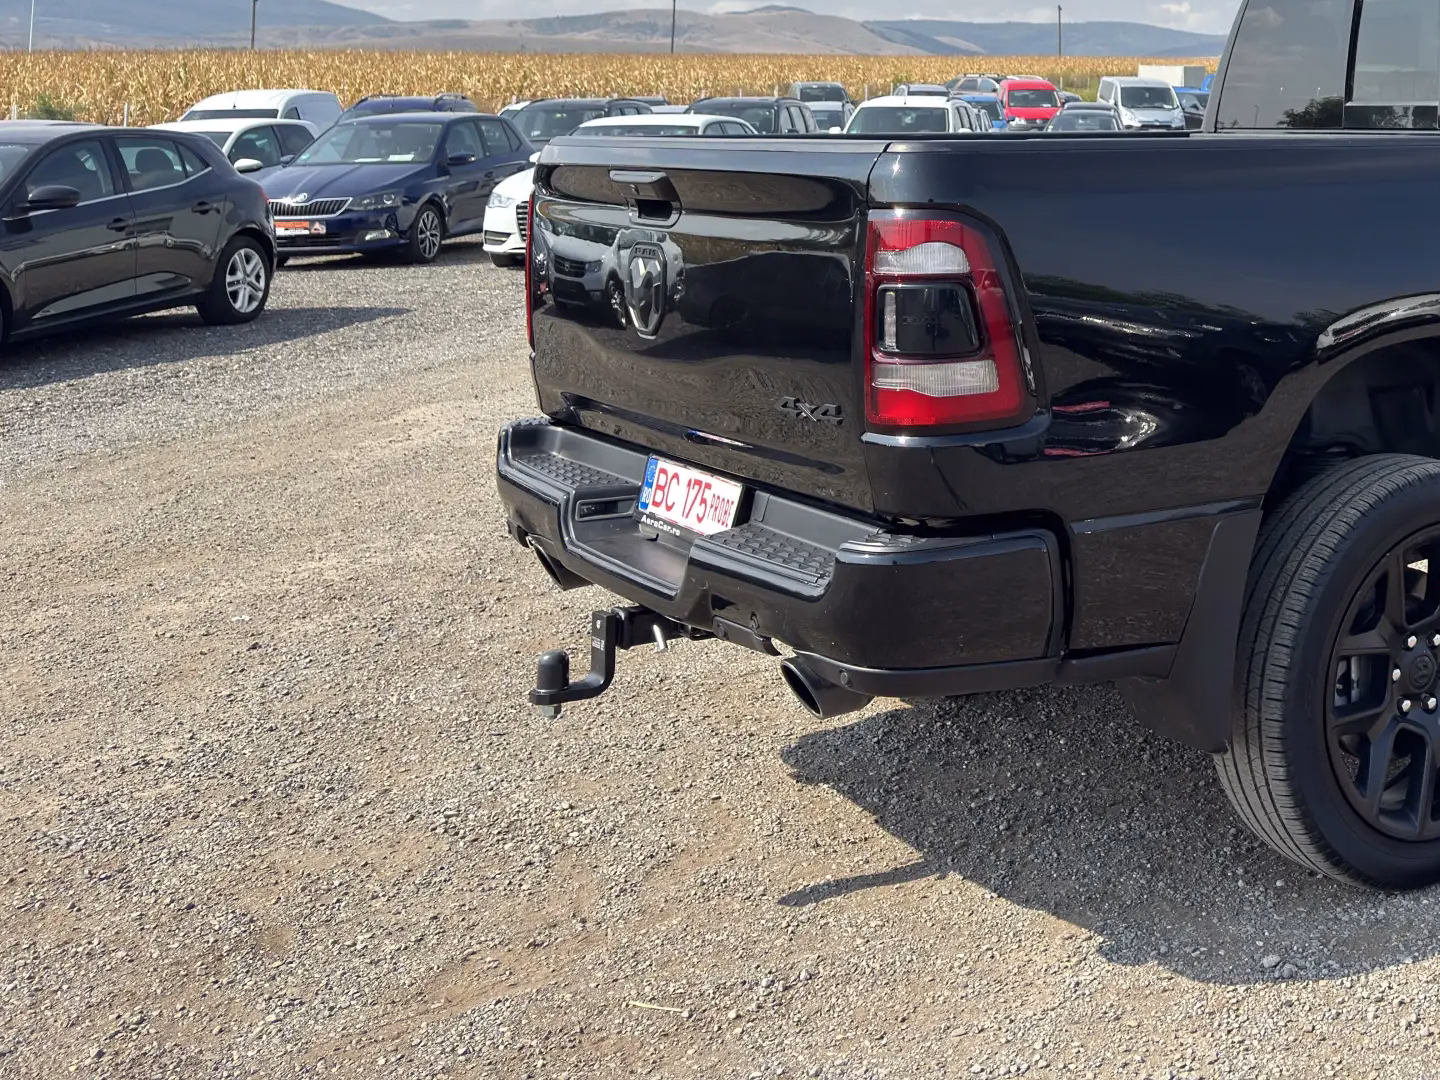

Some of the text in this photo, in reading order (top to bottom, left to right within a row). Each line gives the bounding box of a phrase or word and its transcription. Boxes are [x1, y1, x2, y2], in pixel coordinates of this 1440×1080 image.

[775, 395, 845, 426] 4x4
[651, 467, 735, 529] BC 175 PROBE
[640, 514, 681, 537] AeroCar.ro
